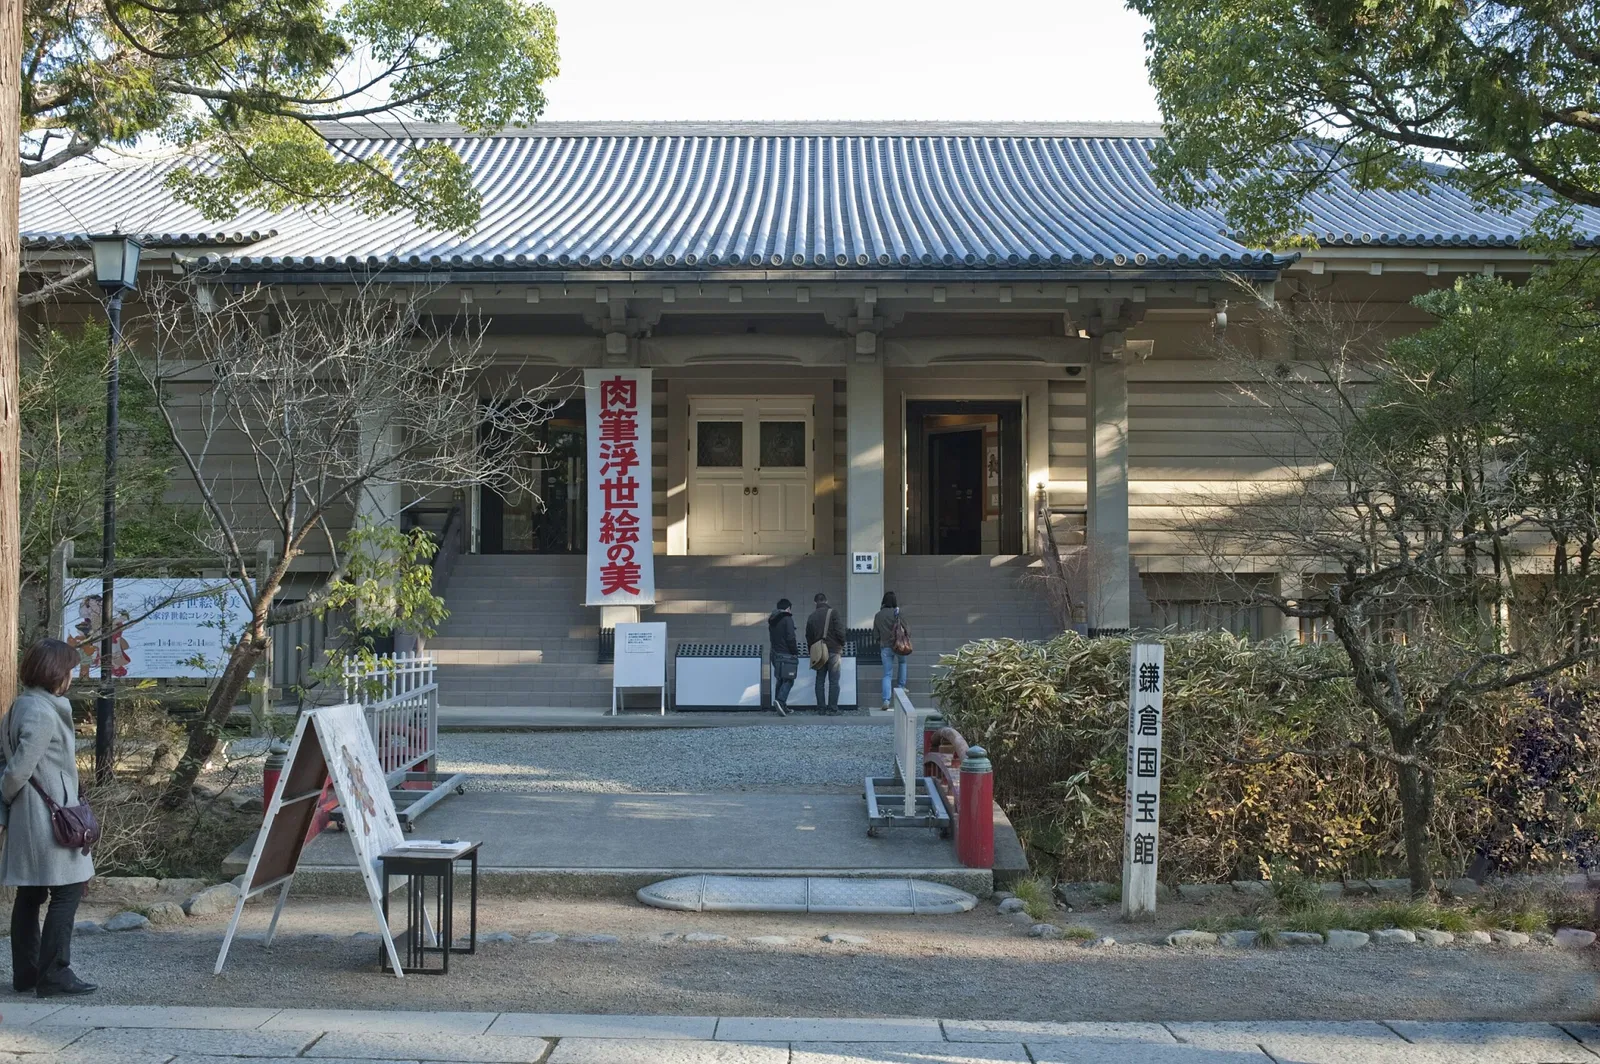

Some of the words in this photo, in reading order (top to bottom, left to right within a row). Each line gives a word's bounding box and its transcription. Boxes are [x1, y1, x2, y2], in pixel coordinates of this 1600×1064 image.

[598, 375, 641, 596] 肉筆浮世絵の美
[1133, 662, 1160, 865] 鎌倉国宝館
